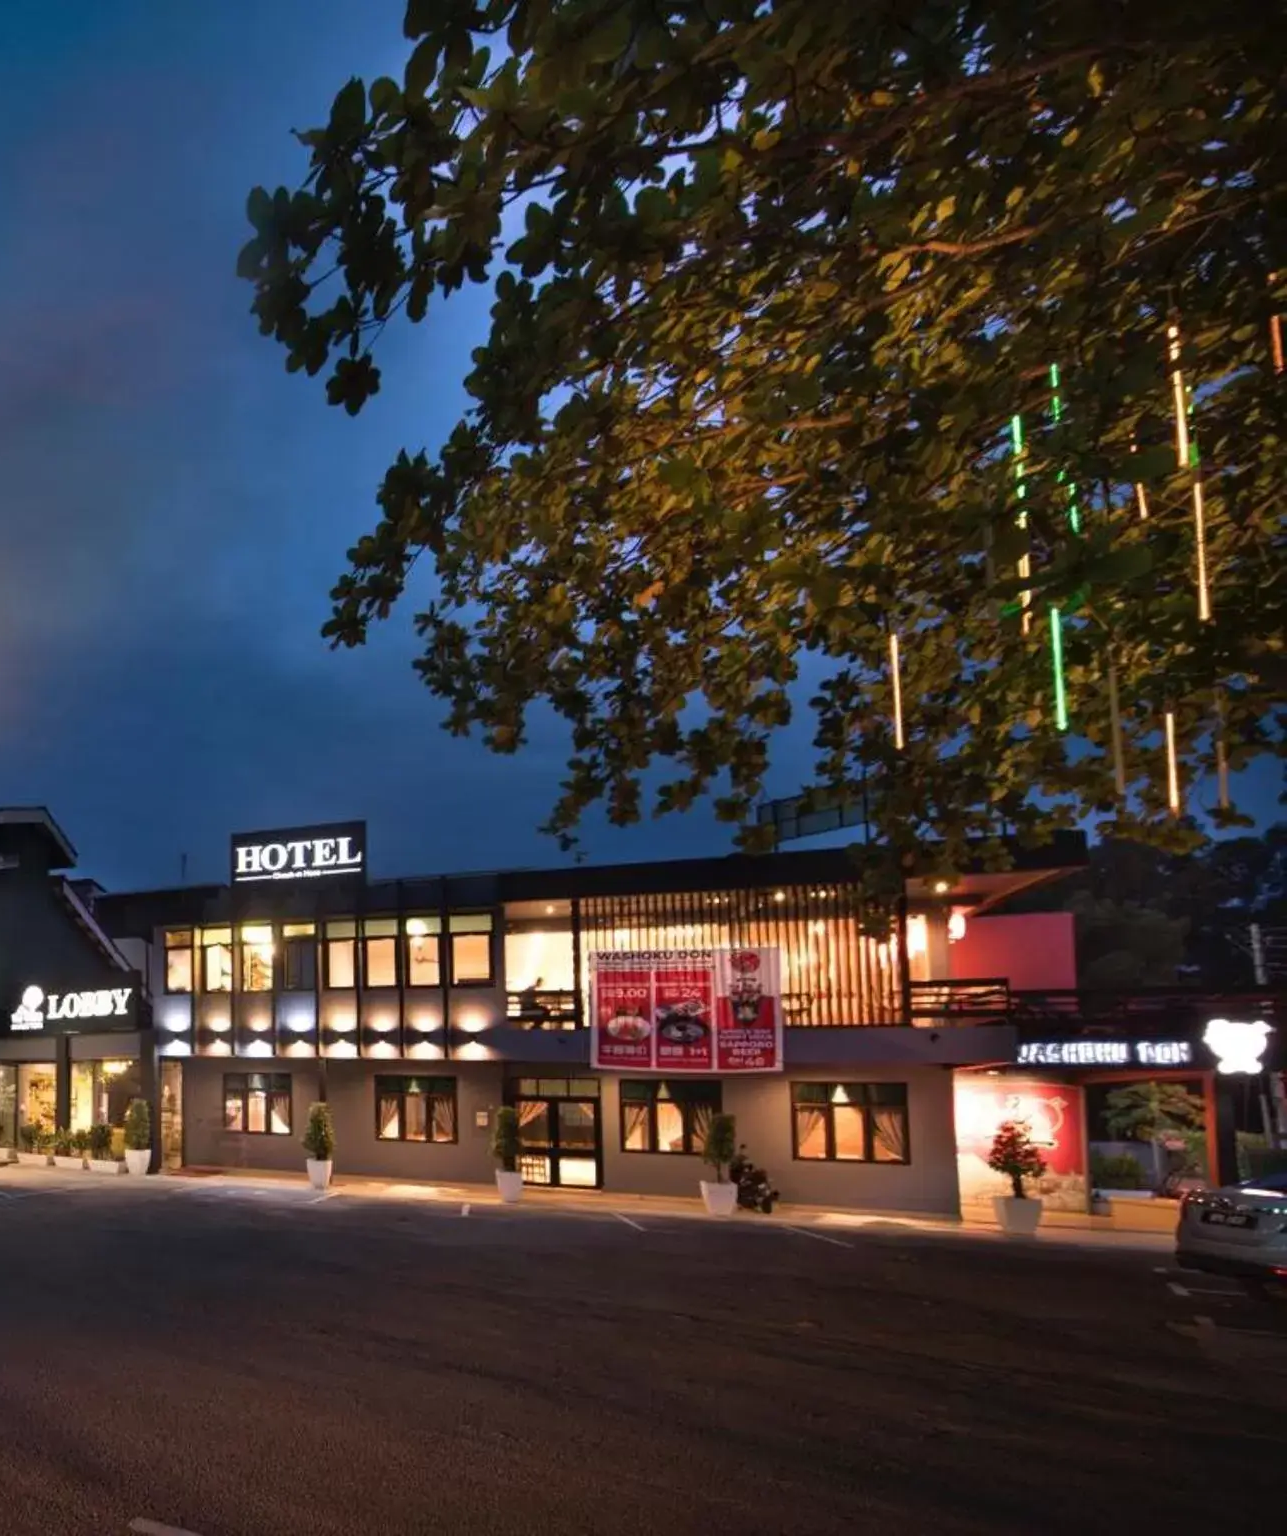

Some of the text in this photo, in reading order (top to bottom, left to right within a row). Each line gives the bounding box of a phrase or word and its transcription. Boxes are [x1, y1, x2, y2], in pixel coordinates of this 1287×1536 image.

[235, 837, 362, 873] HOTEL
[597, 949, 711, 960] WASHOKU DON
[46, 988, 133, 1020] LOBBY
